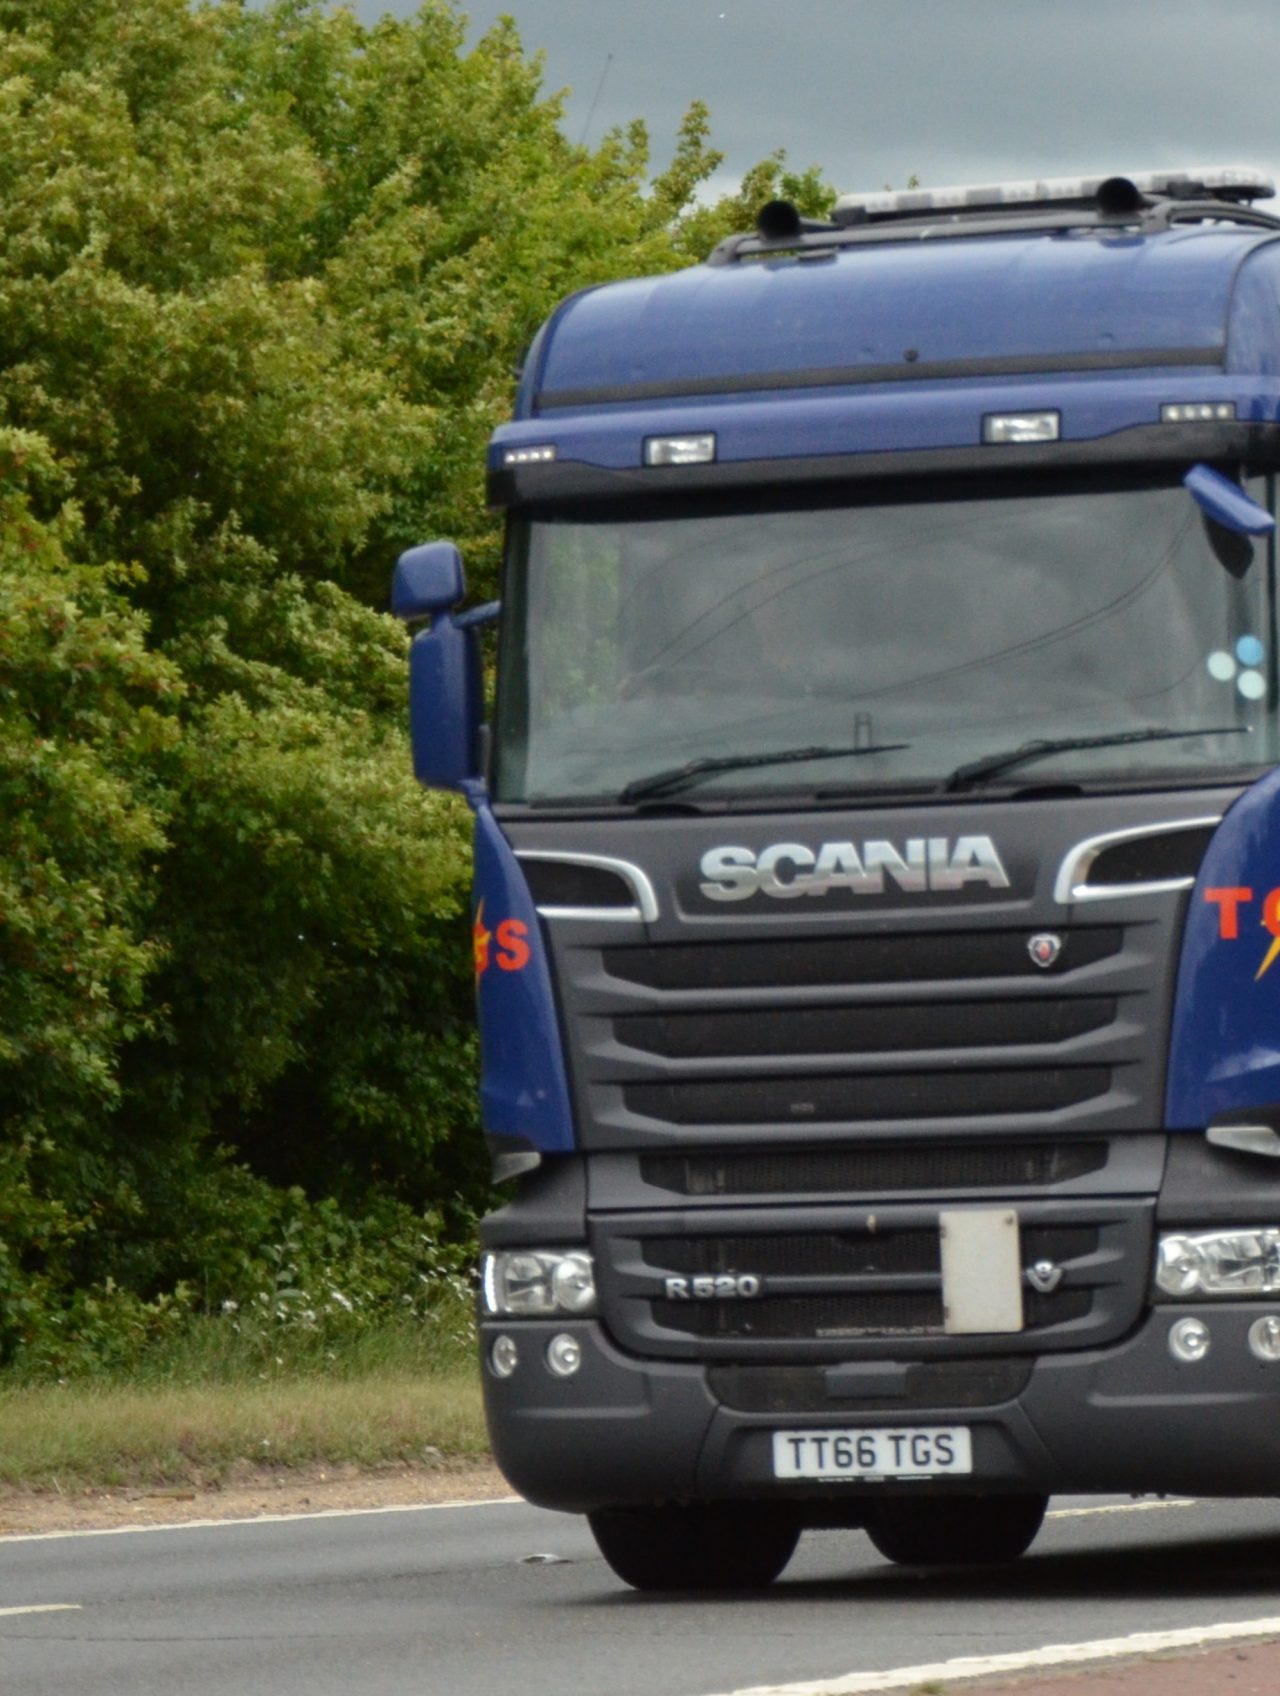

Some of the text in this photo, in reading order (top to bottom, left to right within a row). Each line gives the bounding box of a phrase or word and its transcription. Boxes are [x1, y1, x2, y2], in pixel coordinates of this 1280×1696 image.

[700, 834, 1010, 901] SCANIA
[786, 1433, 955, 1471] TT66 TGS
